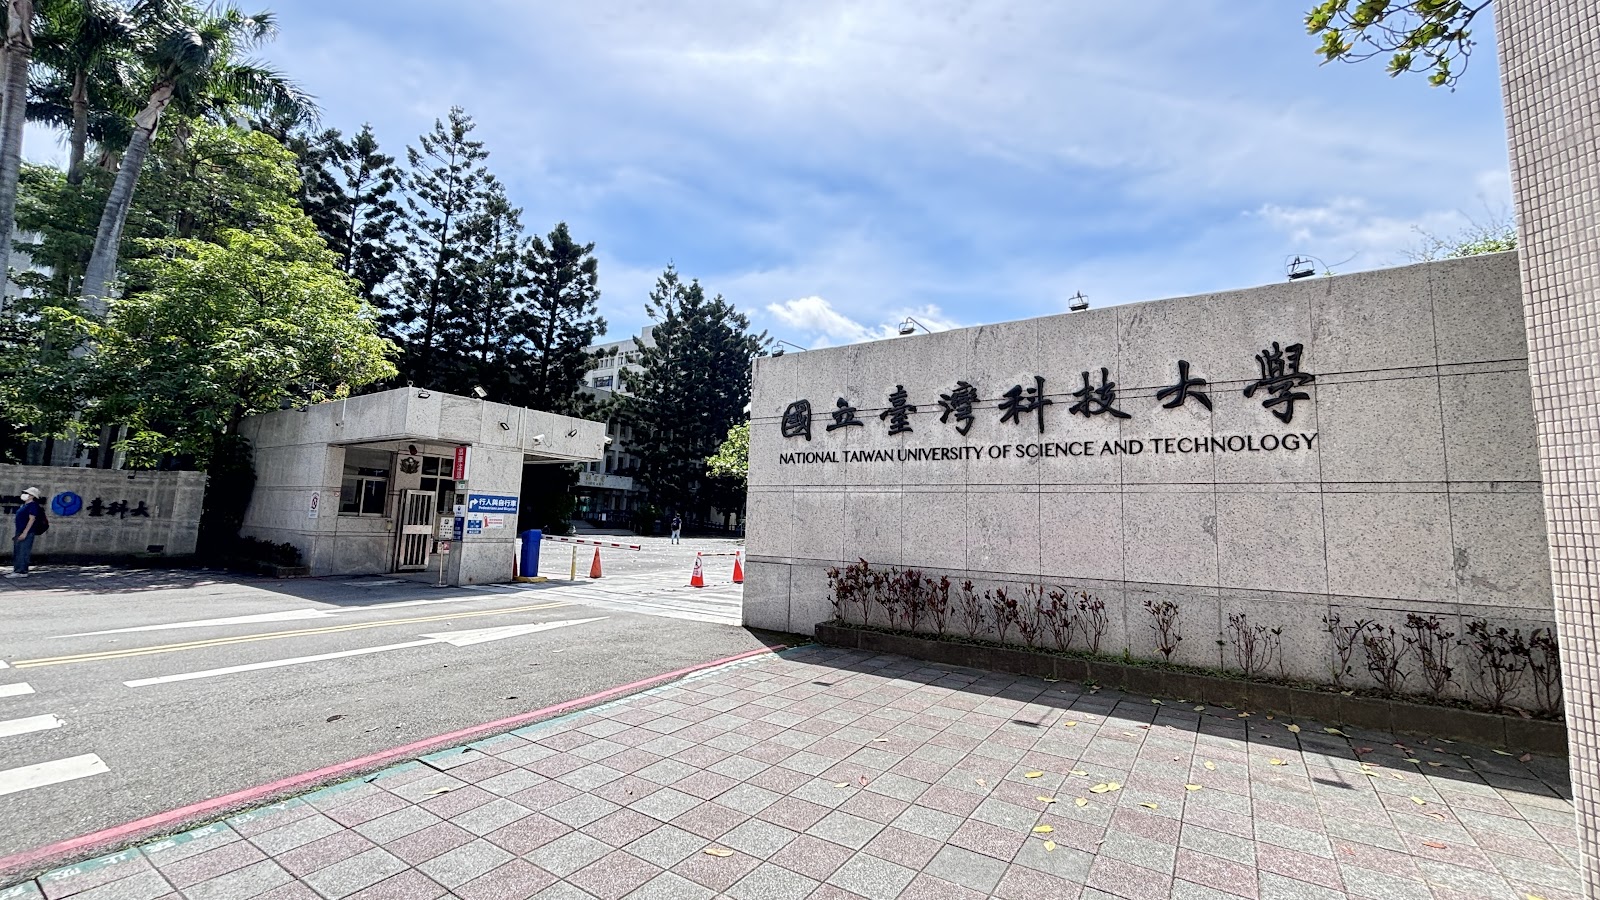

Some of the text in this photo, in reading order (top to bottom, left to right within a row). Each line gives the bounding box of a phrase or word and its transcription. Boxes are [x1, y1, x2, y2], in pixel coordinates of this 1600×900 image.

[781, 341, 1315, 441] 國立臺灣科技大學
[779, 432, 1318, 465] NATIONAL TAIWAN UNIVERSITY OF SCIENCE AND TECHNOLOGY
[86, 497, 150, 519] 臺科大
[479, 498, 516, 507] 行人與自行車
